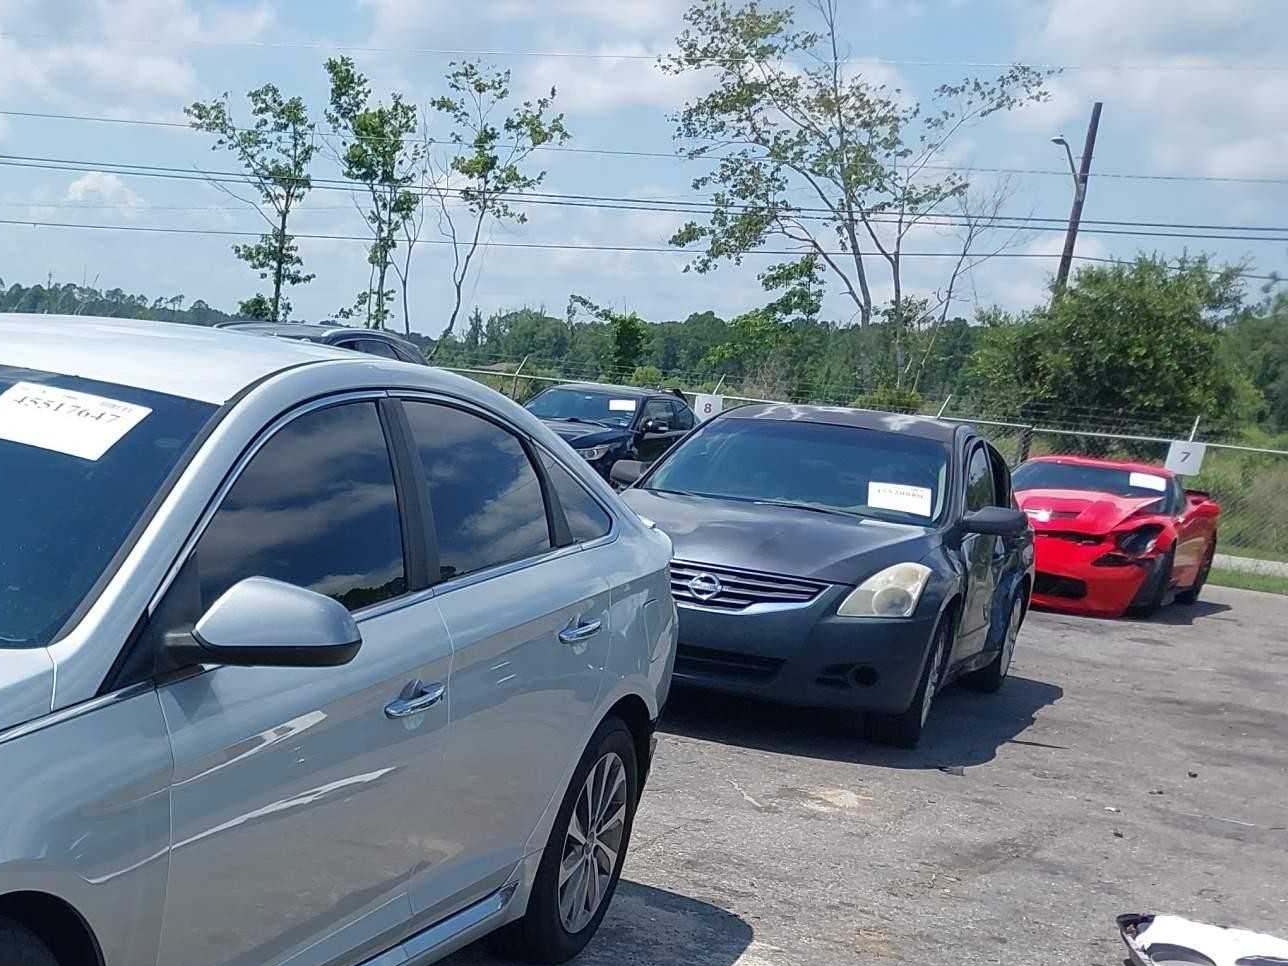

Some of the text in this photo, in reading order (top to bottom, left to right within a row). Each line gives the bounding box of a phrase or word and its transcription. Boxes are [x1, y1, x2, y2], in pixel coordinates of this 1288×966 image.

[11, 394, 121, 424] 45517647
[703, 402, 713, 414] 8
[1180, 451, 1192, 463] 7
